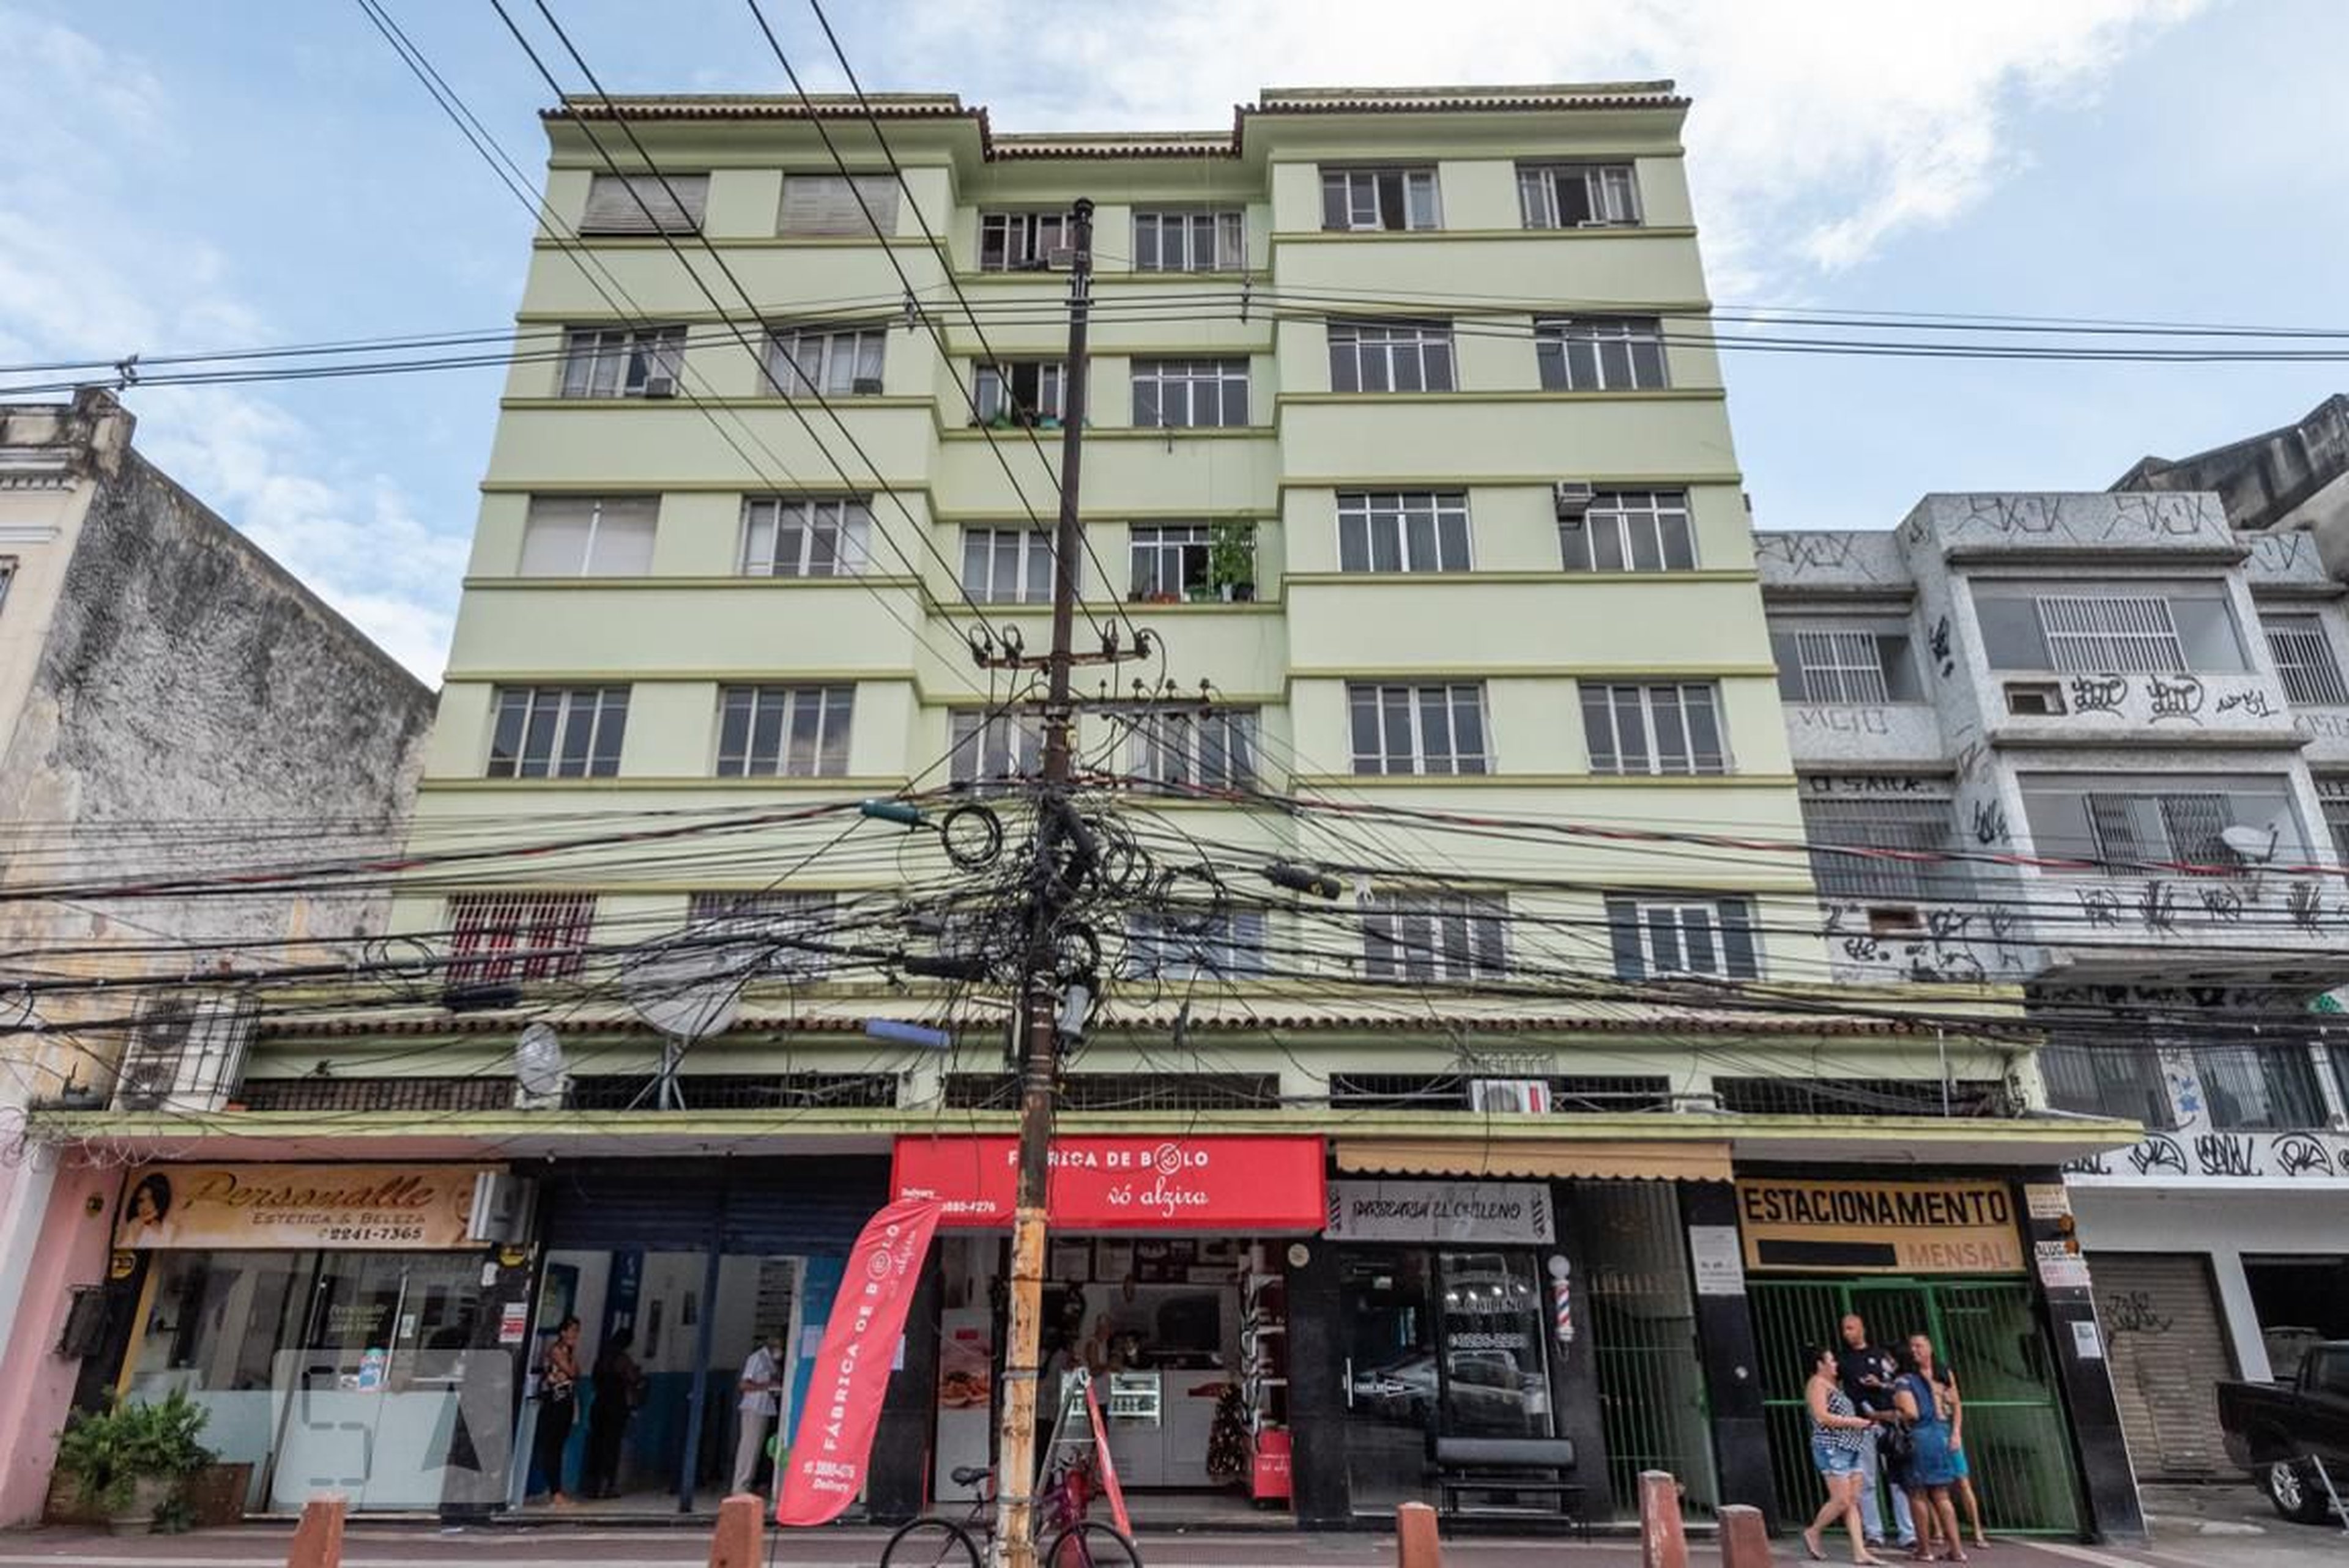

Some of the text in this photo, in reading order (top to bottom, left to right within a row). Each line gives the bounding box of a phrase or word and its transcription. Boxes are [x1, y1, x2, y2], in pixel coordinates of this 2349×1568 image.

[1008, 1142, 1209, 1175] FRICA DE BOLO
[183, 1170, 434, 1209] Personalle
[1107, 1175, 1209, 1218] vó alzira
[360, 1211, 426, 1224] BELEZA
[1453, 1199, 1521, 1219] CHILENO
[1742, 1187, 2009, 1225] ESTACIONAMENTO
[329, 1227, 423, 1241] 2241-7365
[1906, 1243, 2011, 1268] MENSAL
[855, 1306, 874, 1333] DE
